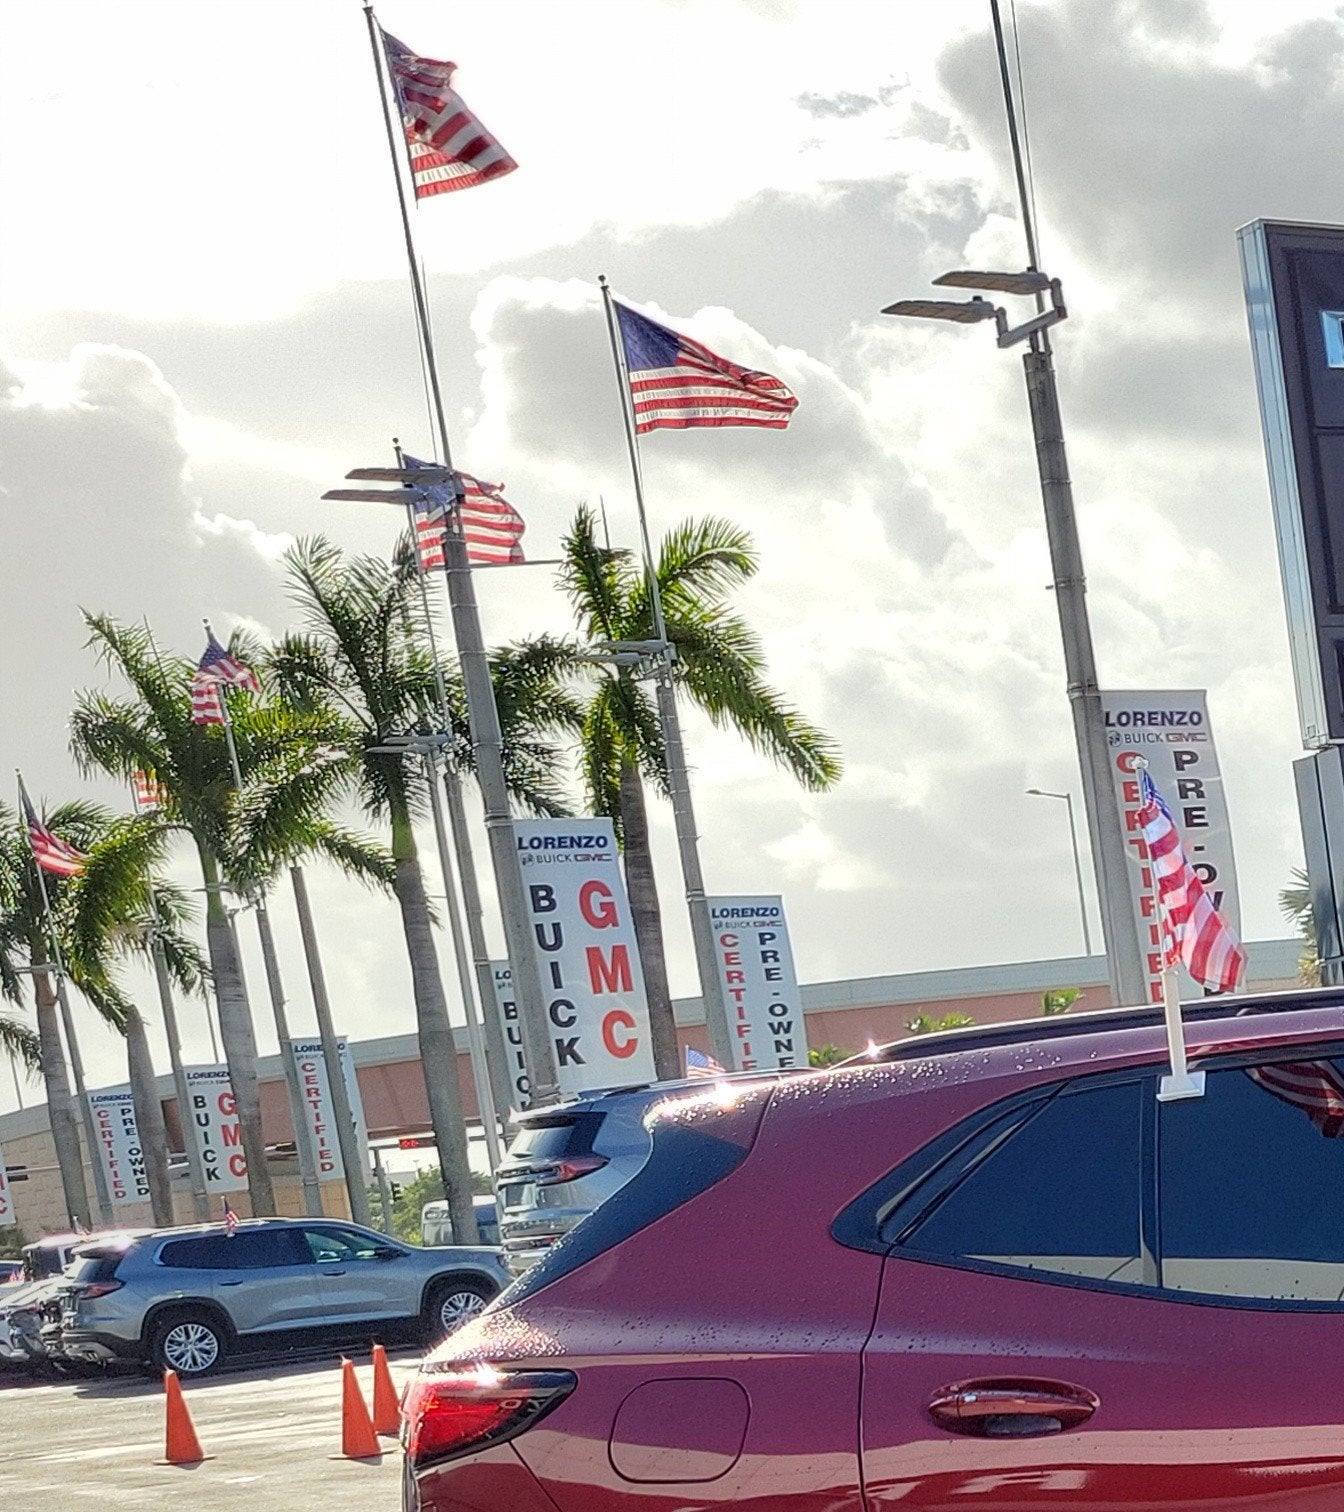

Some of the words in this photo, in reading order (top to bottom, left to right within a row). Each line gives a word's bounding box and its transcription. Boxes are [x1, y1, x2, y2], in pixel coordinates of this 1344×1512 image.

[1105, 710, 1203, 728] LORENZO
[1124, 732, 1164, 744] BUICK
[1166, 732, 1208, 743] GMC
[517, 835, 608, 850] LORENZO
[536, 853, 573, 863] BUICK
[574, 853, 612, 862] GMC
[711, 907, 779, 919] LORENZO
[529, 884, 587, 1067] BUICK
[578, 880, 639, 1059] GMC
[719, 933, 758, 1070] CERTIFIE
[758, 932, 796, 1068] PRE-OWNE
[97, 1109, 126, 1199] CERTIFIED
[193, 1095, 222, 1181] BUICK
[217, 1092, 248, 1178] GMC
[301, 1062, 335, 1173] CERTIFIED
